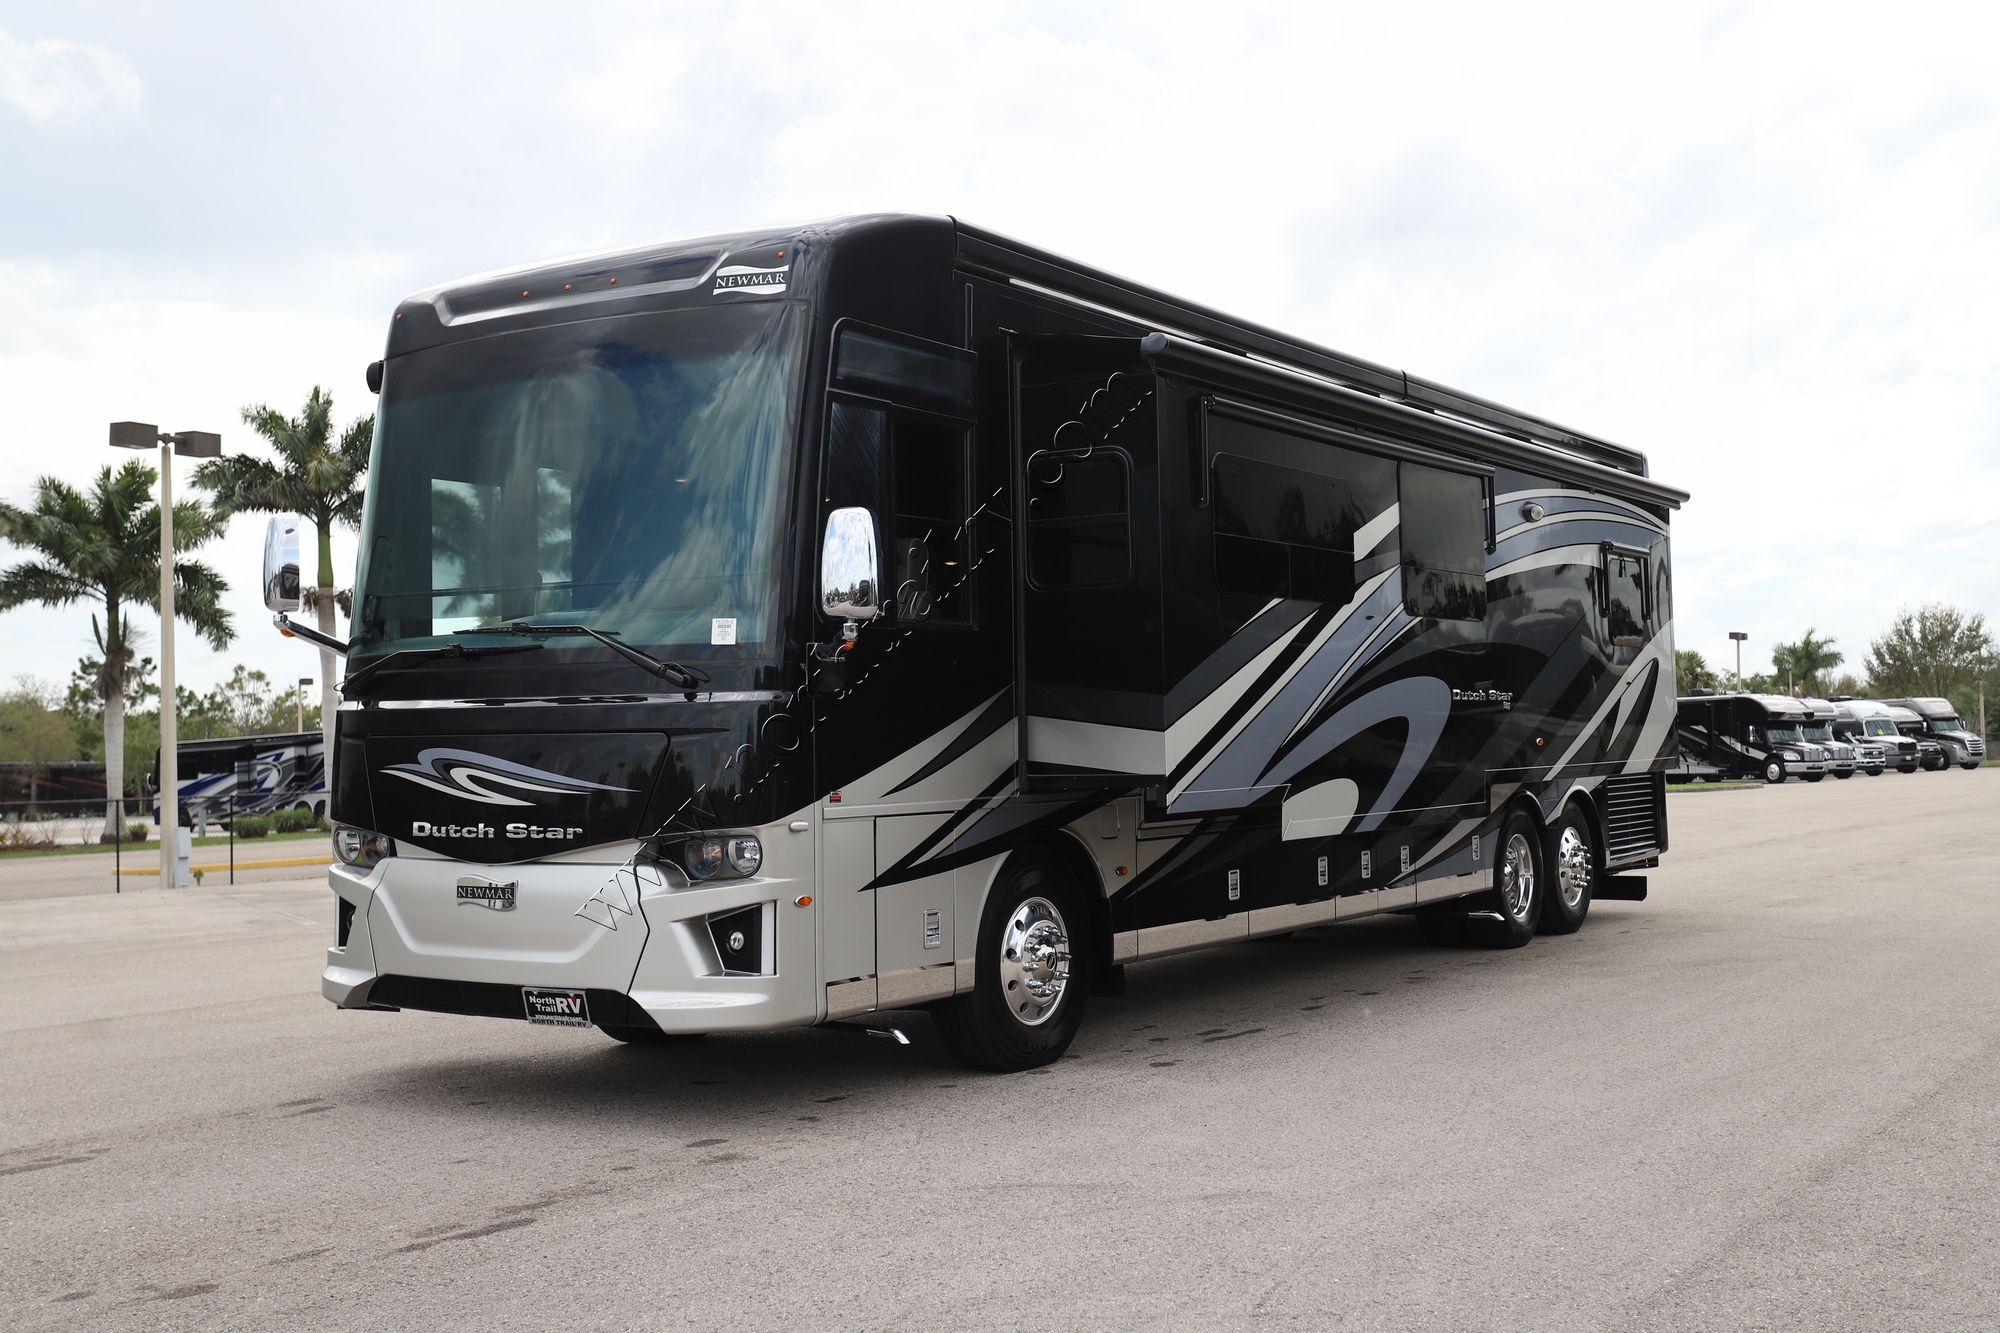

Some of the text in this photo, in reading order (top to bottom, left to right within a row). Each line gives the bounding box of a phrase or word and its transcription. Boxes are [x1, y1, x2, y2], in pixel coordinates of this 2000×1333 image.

[715, 272, 786, 288] NEWMAR
[1452, 689, 1514, 701] Dutch Star
[412, 821, 583, 840] Dutch Star
[457, 887, 513, 899] NEWMAR
[529, 996, 555, 1004] North
[555, 997, 581, 1014] RV
[535, 1004, 557, 1012] Trail
